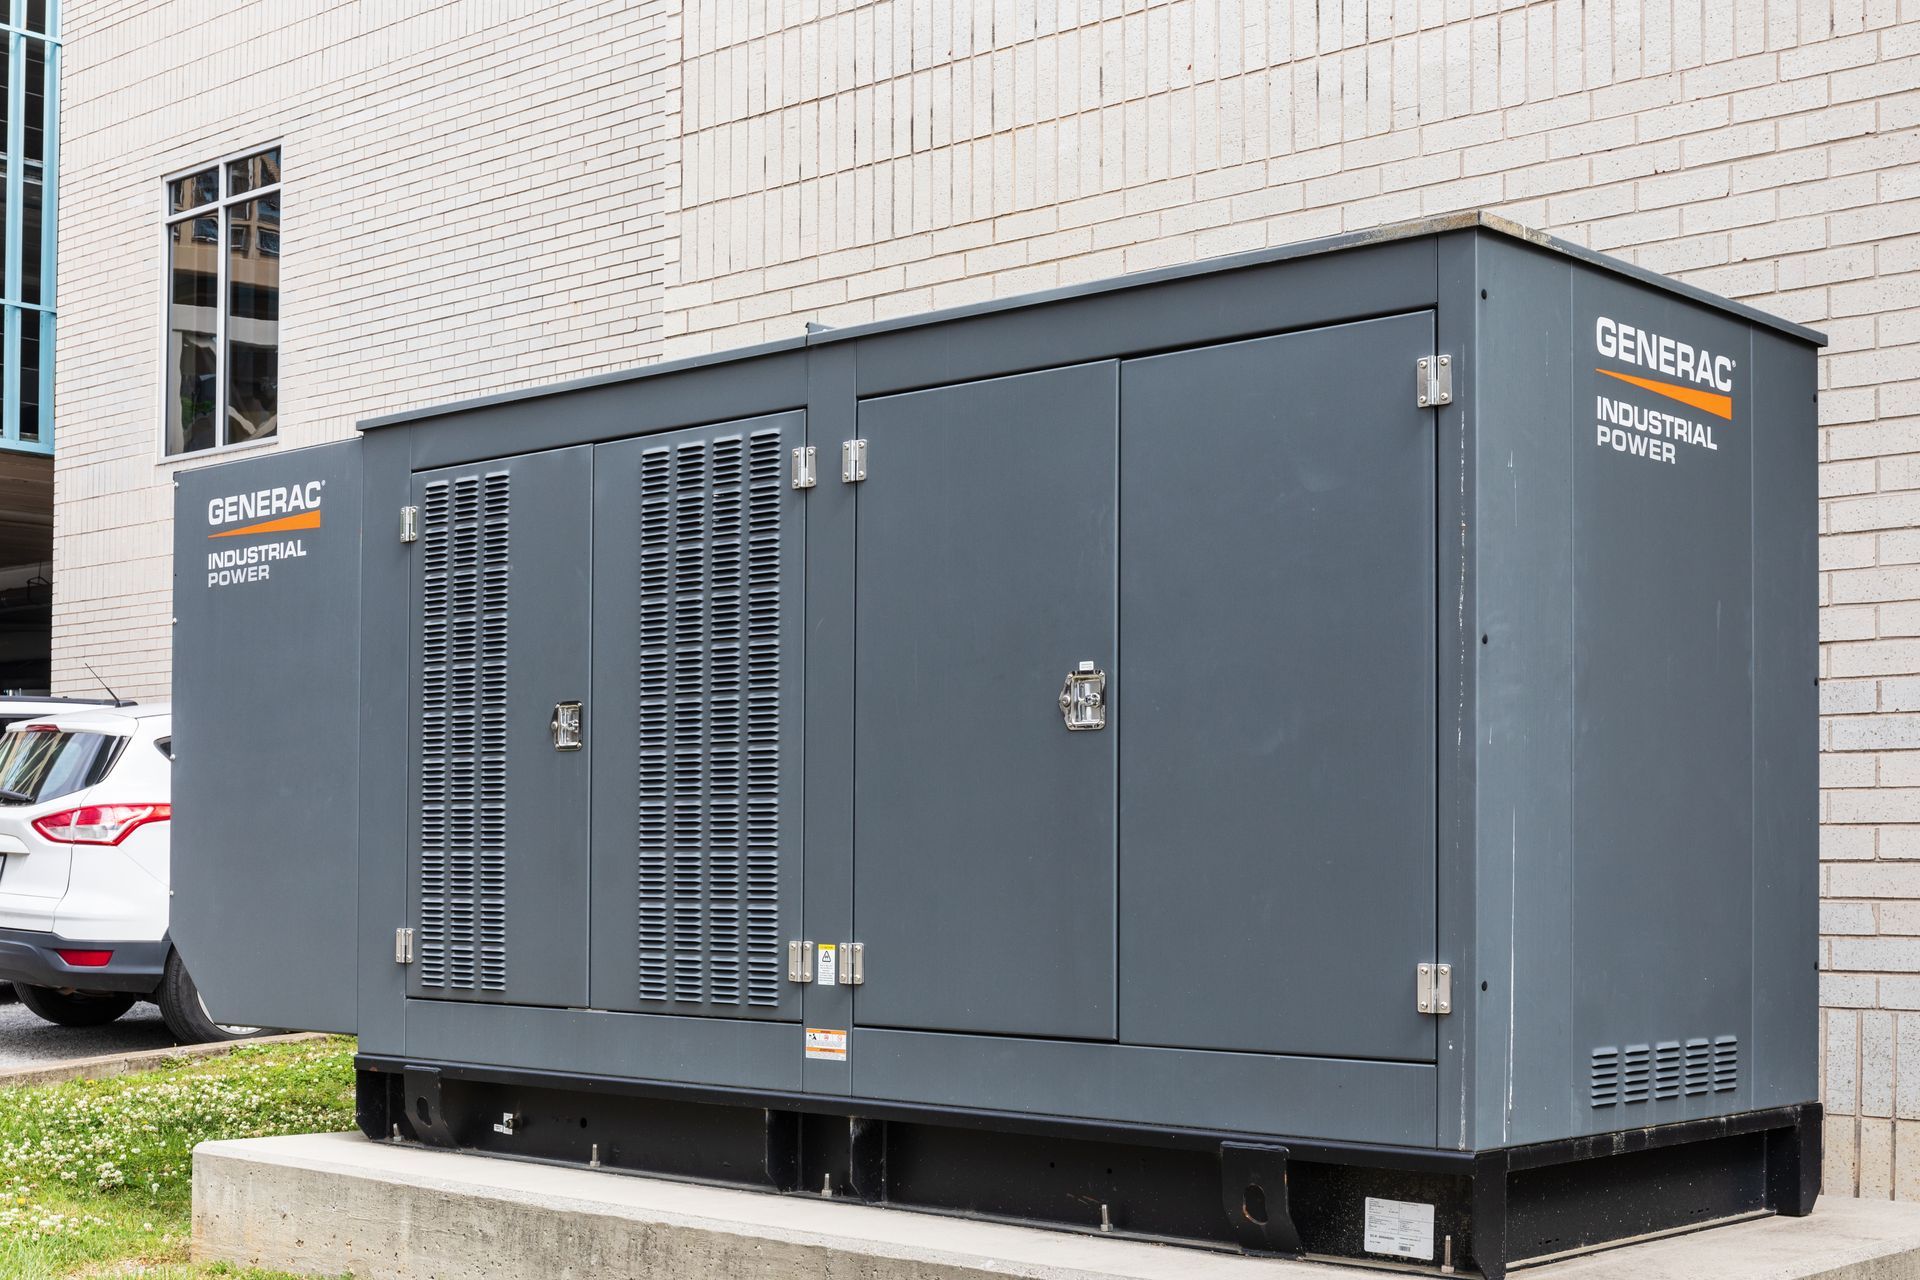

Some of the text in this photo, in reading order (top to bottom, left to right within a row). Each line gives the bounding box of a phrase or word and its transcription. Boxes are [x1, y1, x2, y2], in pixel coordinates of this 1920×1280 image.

[1596, 395, 1718, 451] INDUSTRIAL
[1596, 425, 1676, 465] POWER
[208, 480, 321, 525] GENERAC
[208, 540, 307, 570] INDUSTRIAL
[208, 564, 270, 588] POWER
